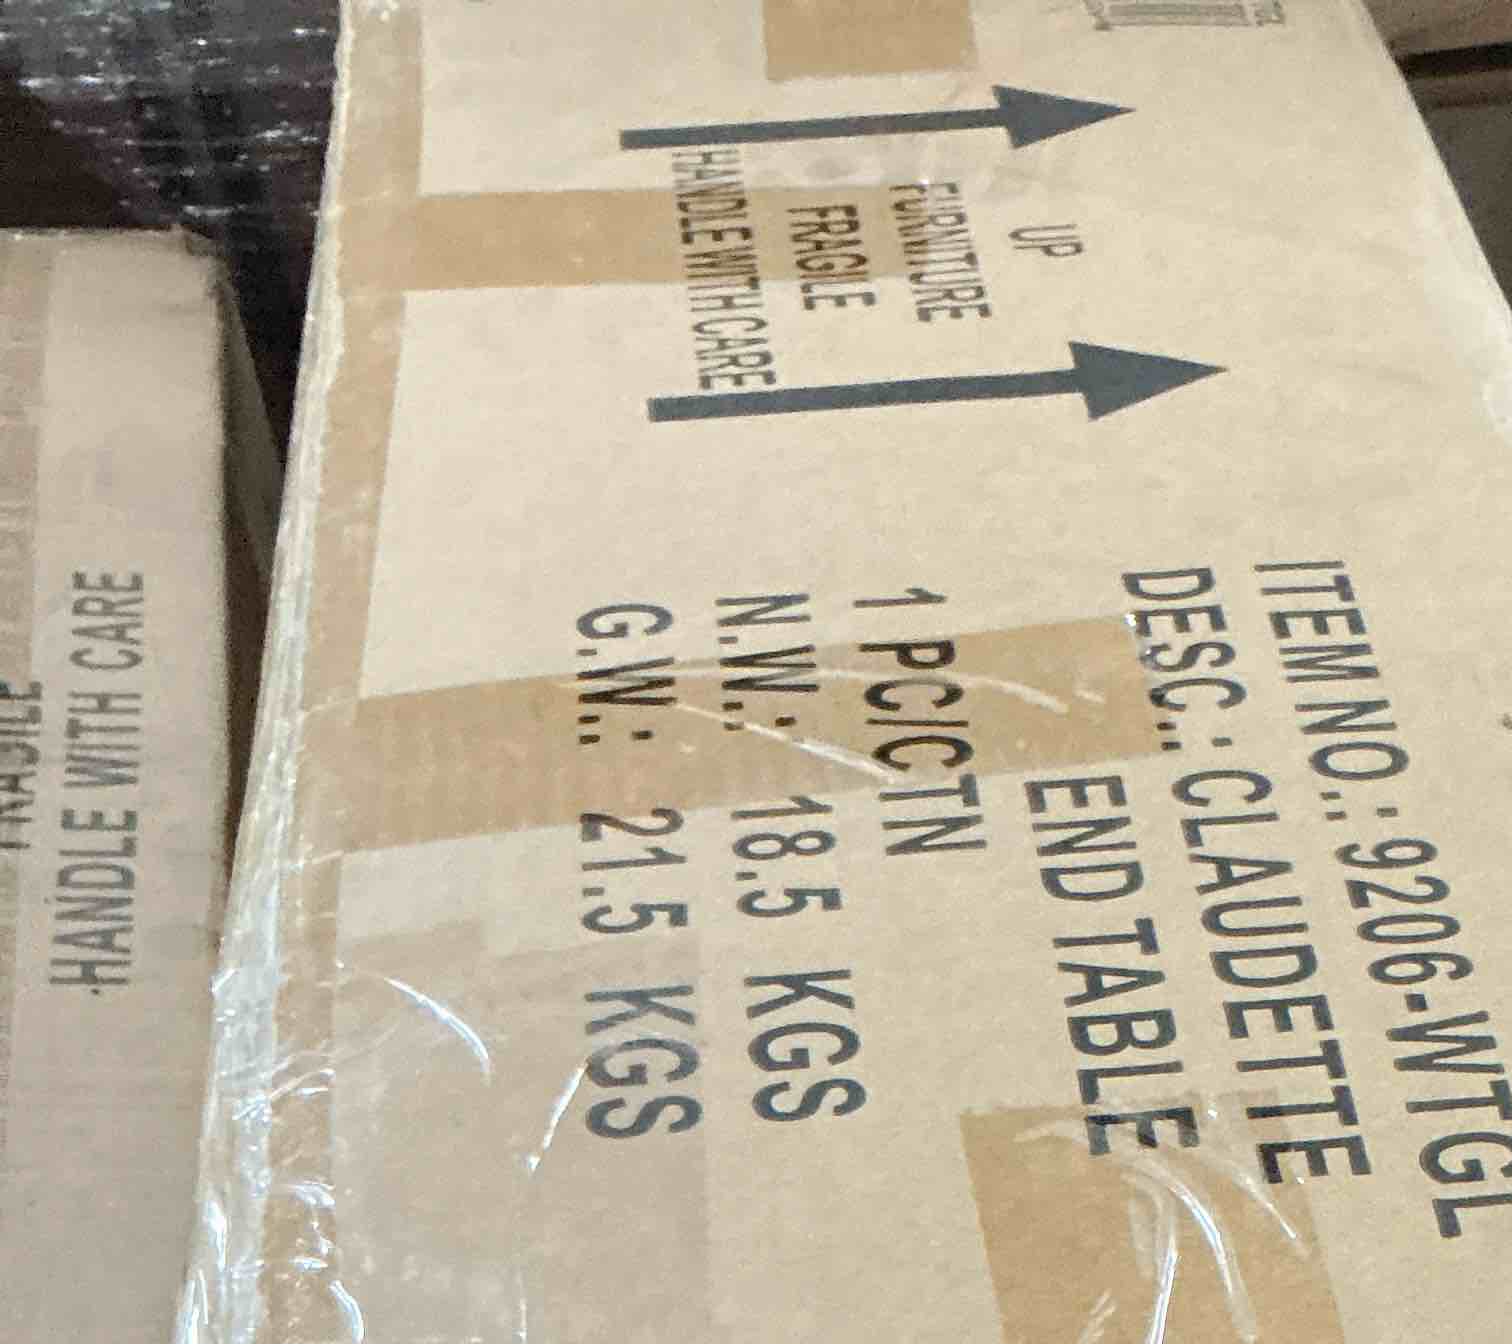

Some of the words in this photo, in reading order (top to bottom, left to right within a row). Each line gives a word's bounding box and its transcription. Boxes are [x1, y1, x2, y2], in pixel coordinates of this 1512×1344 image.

[675, 151, 753, 244] HANDLE
[788, 205, 876, 310] FRAGILE
[890, 183, 991, 322] FURNITURE
[1009, 225, 1083, 257] UP
[685, 246, 762, 312] WITH
[692, 317, 781, 393] CARE
[70, 571, 144, 671] CARE
[854, 588, 946, 608] 1
[1254, 561, 1380, 683] ITEM
[64, 692, 142, 788] WITH
[858, 640, 986, 855] PC/CTN
[49, 808, 137, 985] HANDLE
[580, 808, 688, 933] 21.5
[731, 797, 841, 917] 18.5
[1024, 776, 1143, 901] END
[1053, 918, 1198, 1155] TABLE
[1172, 770, 1371, 1184] CLAUDETTE
[585, 986, 702, 1139] KGS
[744, 970, 866, 1121] KGS
